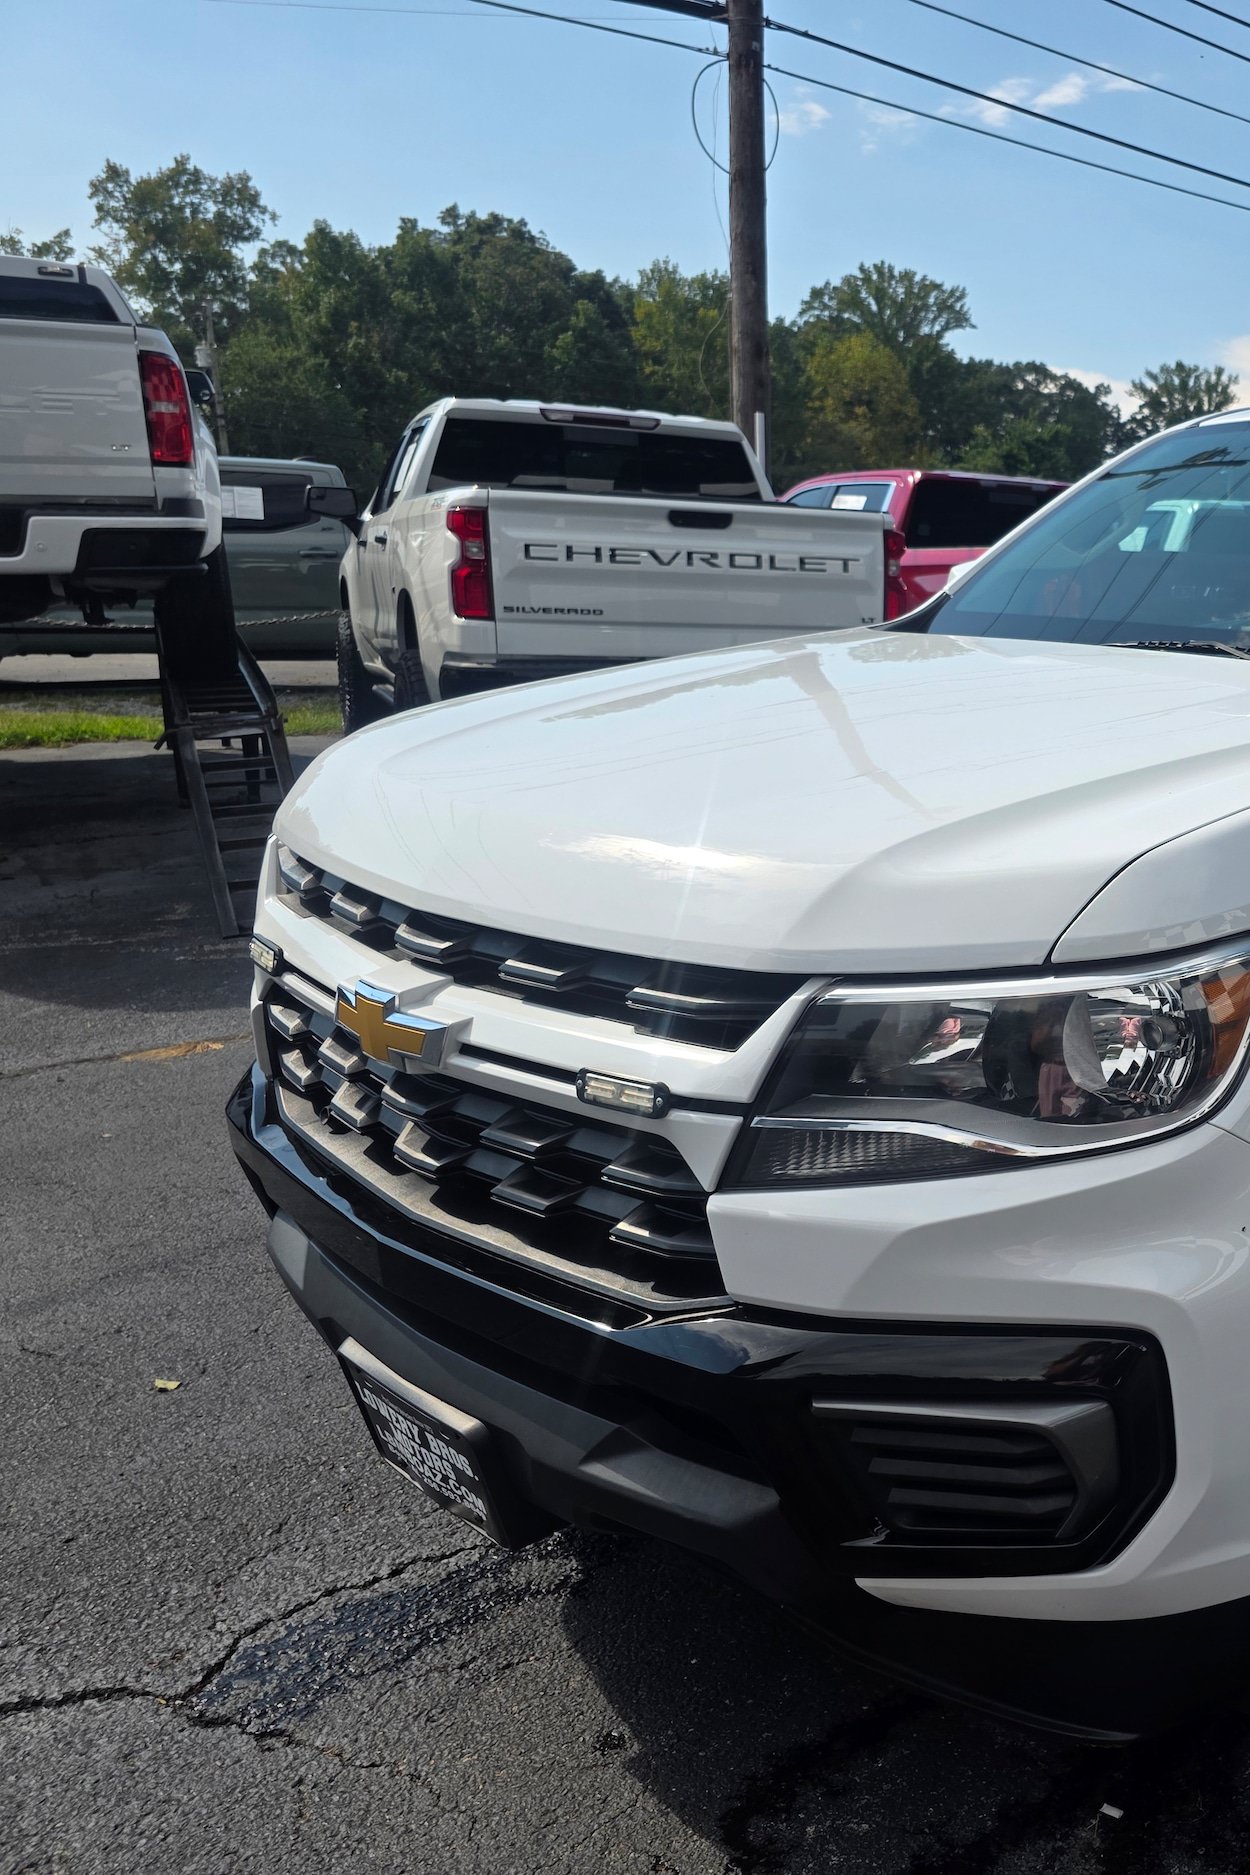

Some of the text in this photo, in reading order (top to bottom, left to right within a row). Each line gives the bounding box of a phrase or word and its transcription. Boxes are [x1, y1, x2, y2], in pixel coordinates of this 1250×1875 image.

[524, 543, 861, 573] CHEVROLET
[503, 606, 604, 616] SILVERADO
[354, 1380, 422, 1444] LOWERY
[425, 1432, 479, 1481] BROS.
[388, 1422, 457, 1480] MOTORS
